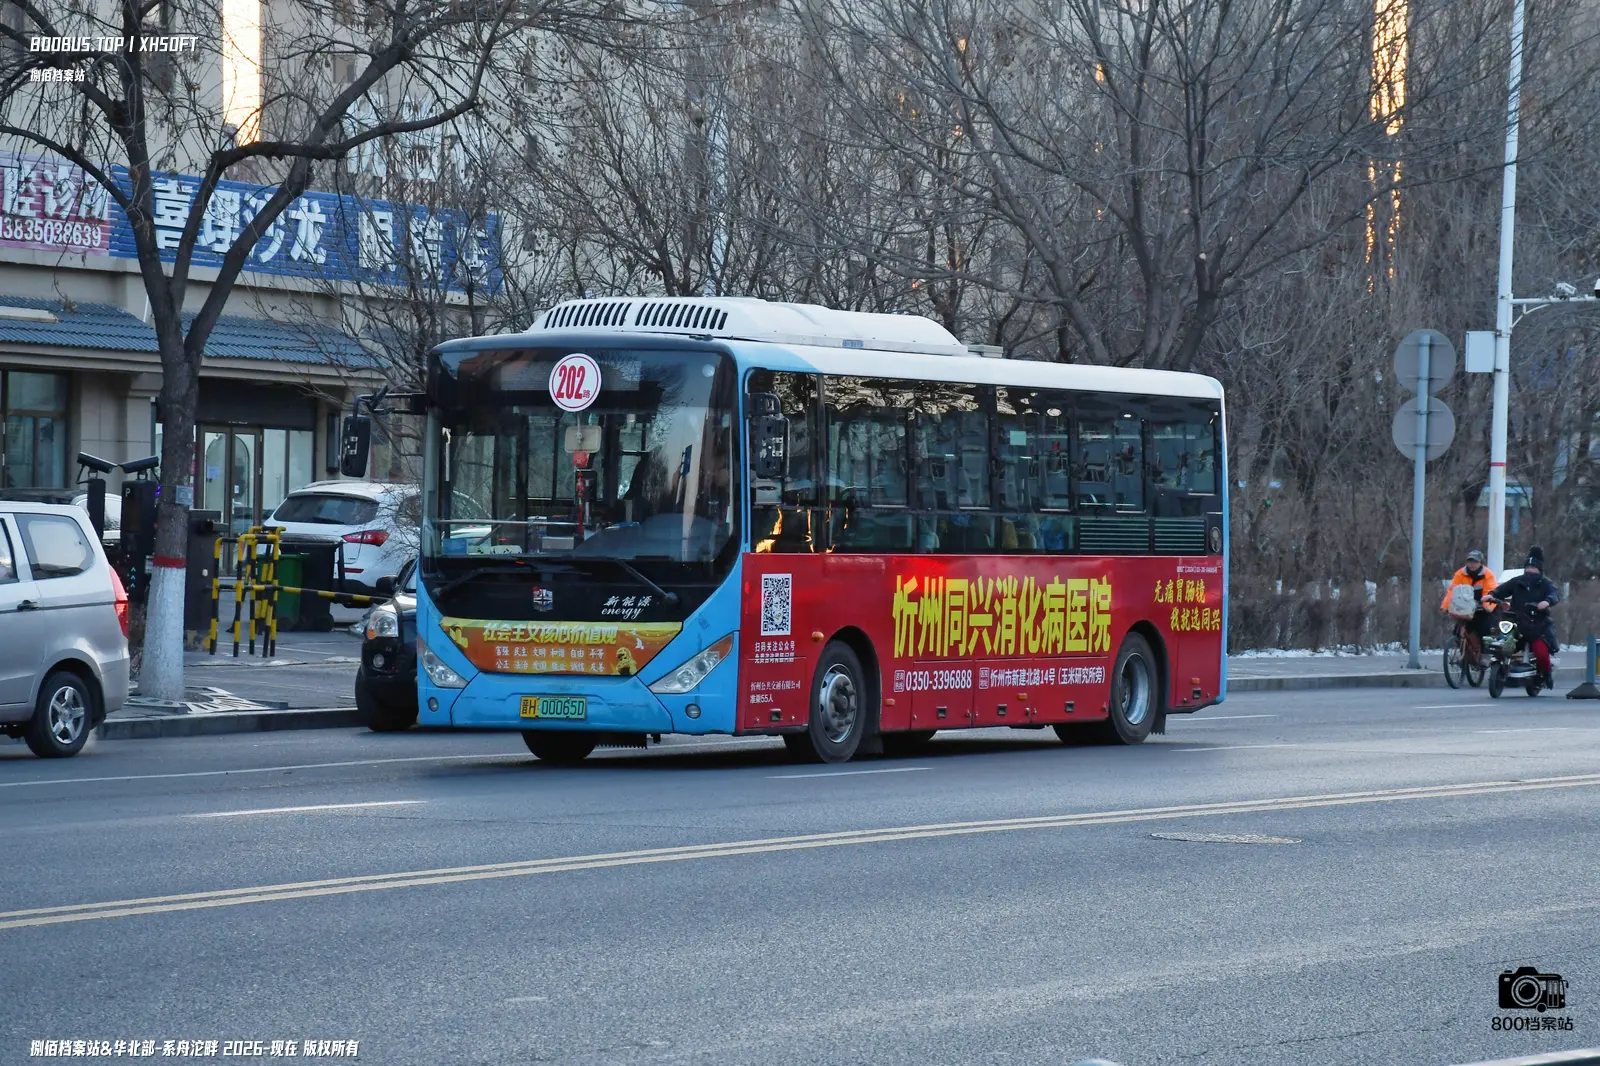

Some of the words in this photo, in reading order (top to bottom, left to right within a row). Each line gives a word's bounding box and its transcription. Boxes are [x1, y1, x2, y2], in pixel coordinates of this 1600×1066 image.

[603, 595, 653, 607] 新能源
[1153, 578, 1206, 604] 无痛胃肠镜
[601, 607, 644, 620] energy
[892, 574, 1112, 659] 忻州同兴消化病医院
[1170, 606, 1221, 631] 我就选同兴
[483, 622, 619, 645] 社会主义核心价值观
[570, 648, 585, 658] 自由
[754, 641, 796, 652] 扫码关注公众号
[905, 669, 973, 691] 0350-3396888
